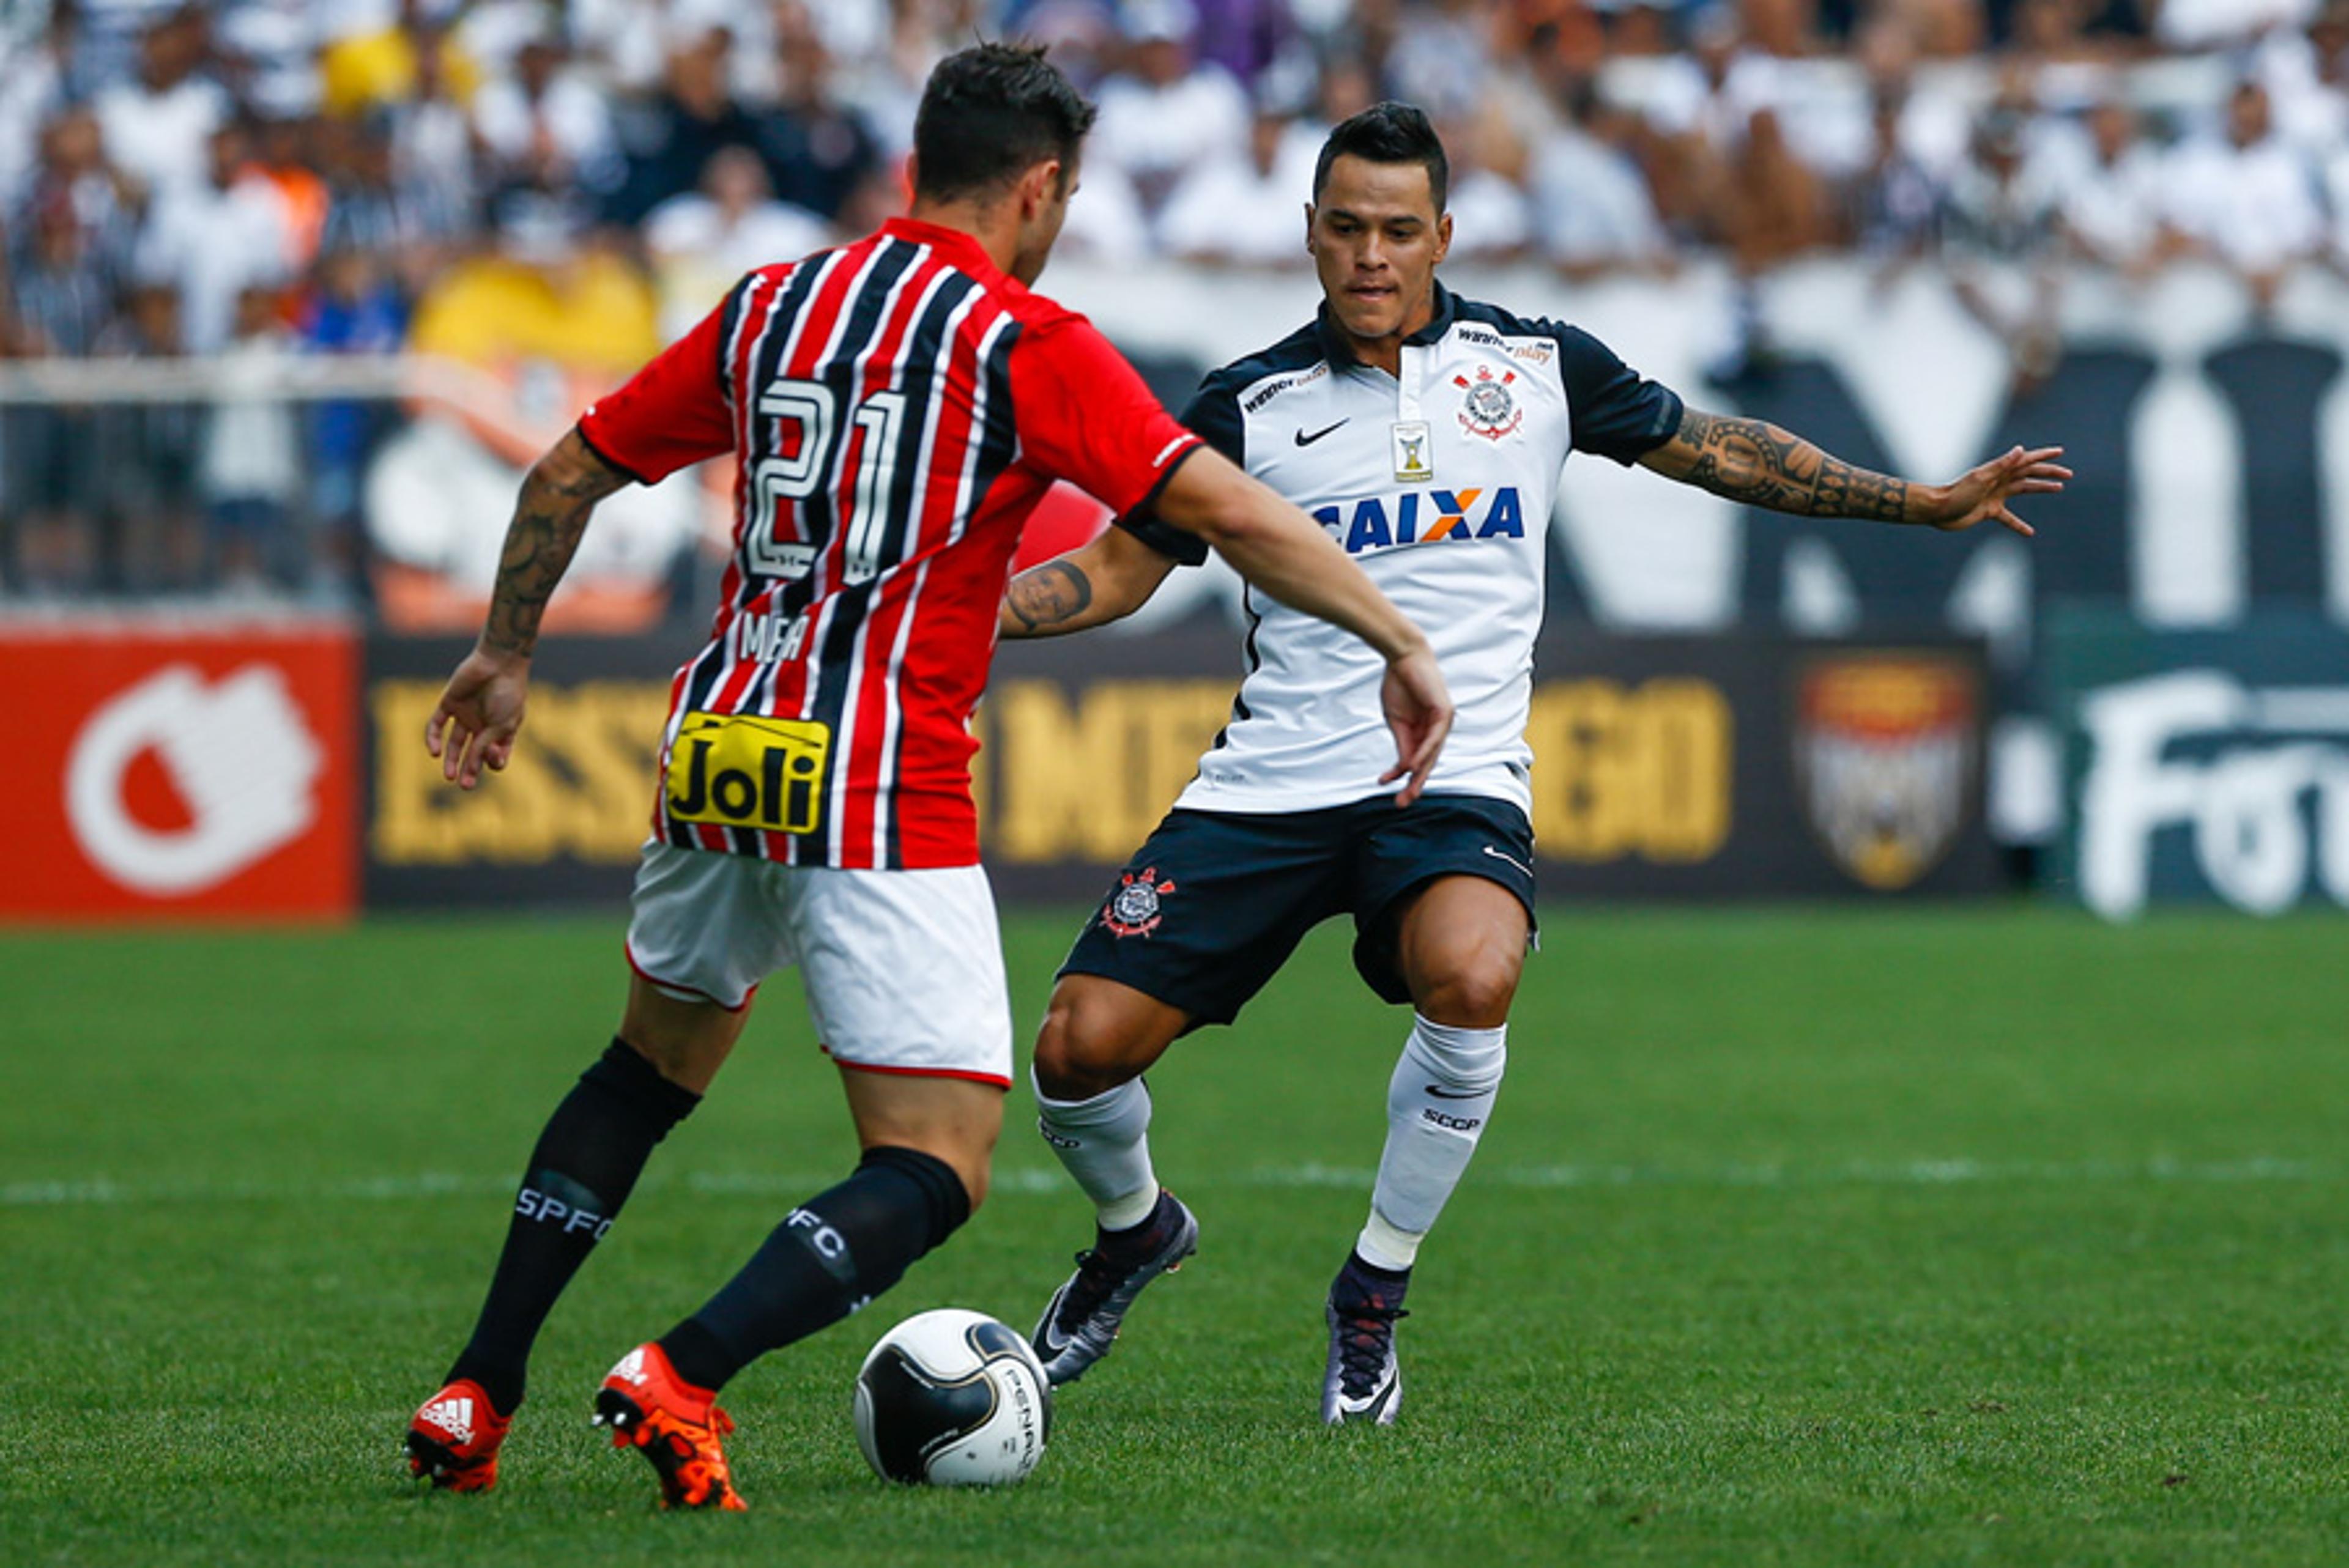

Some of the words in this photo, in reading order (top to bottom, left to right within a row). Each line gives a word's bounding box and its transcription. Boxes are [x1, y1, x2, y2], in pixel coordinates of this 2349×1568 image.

[748, 379, 907, 586] 21
[669, 740, 812, 827] Joli
[788, 1207, 845, 1258] FC
